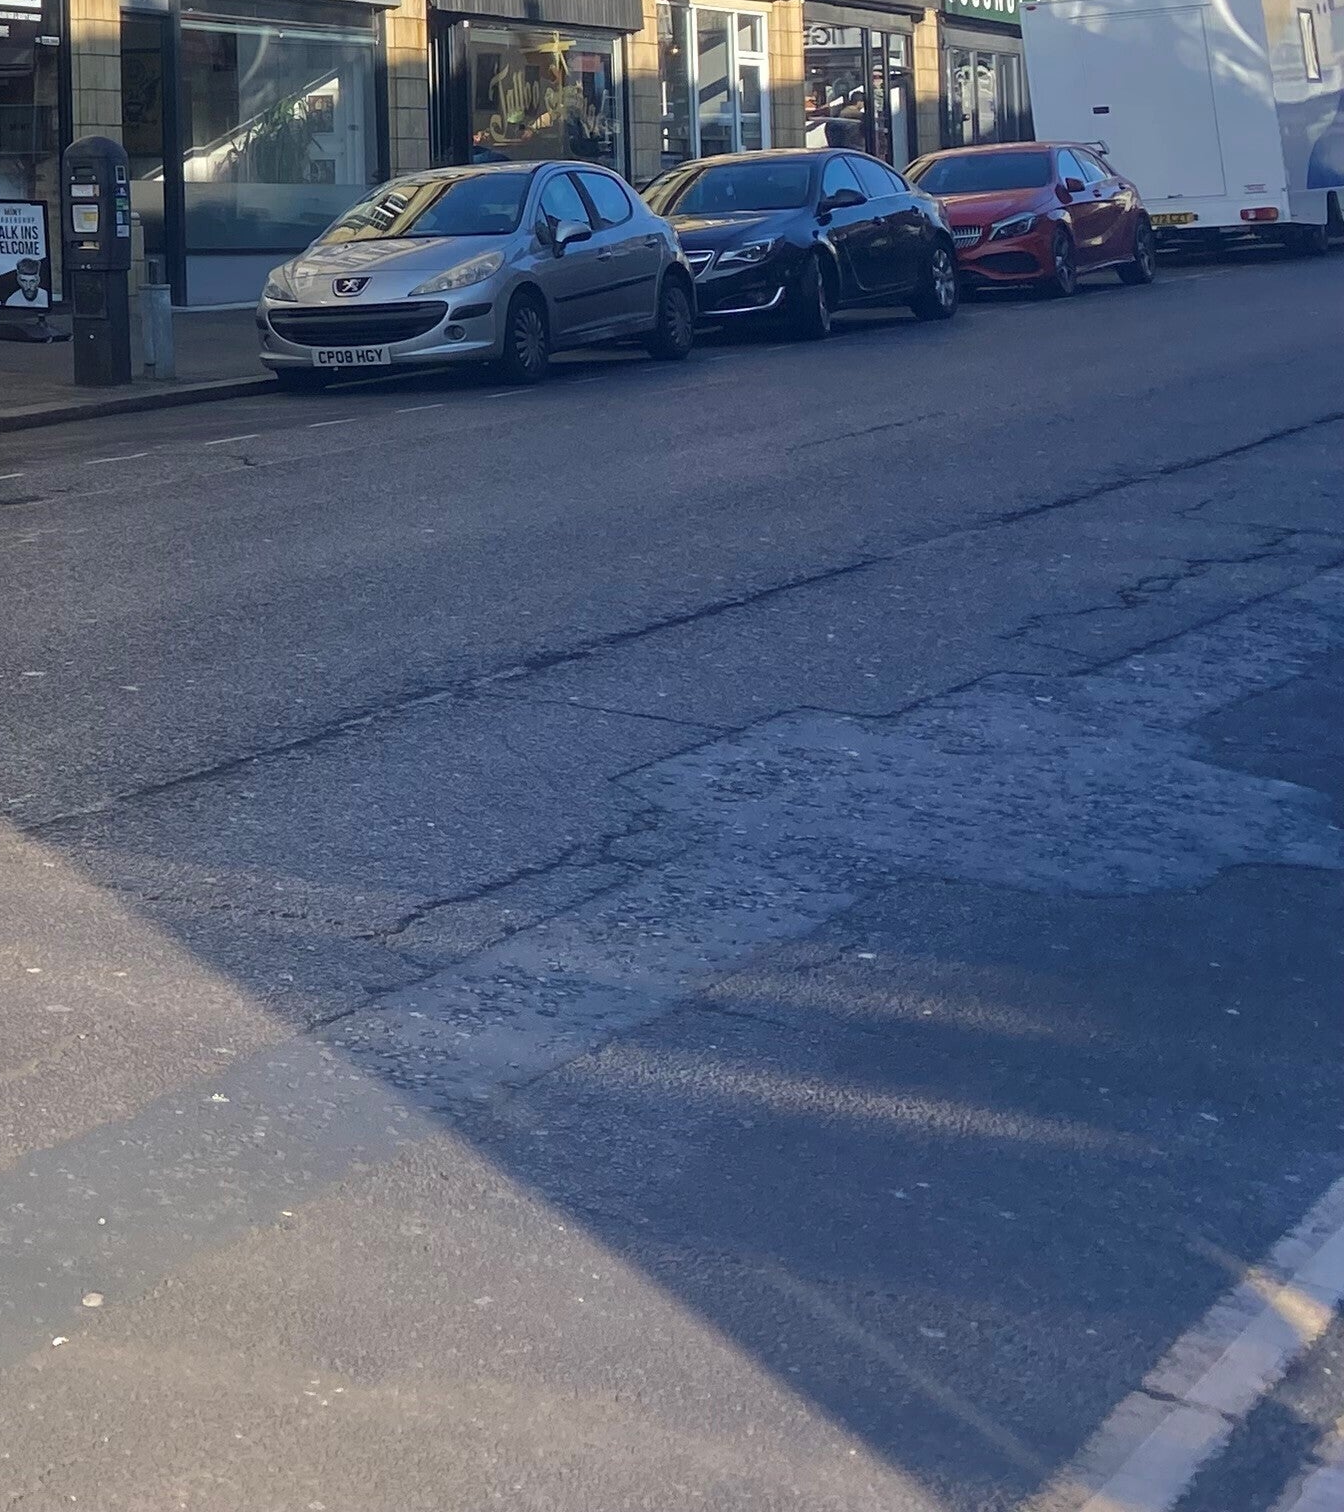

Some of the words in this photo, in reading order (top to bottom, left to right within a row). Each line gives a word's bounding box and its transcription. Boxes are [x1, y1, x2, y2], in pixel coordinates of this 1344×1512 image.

[20, 224, 39, 240] INS
[318, 350, 353, 364] CP08
[356, 348, 384, 363] HGY
